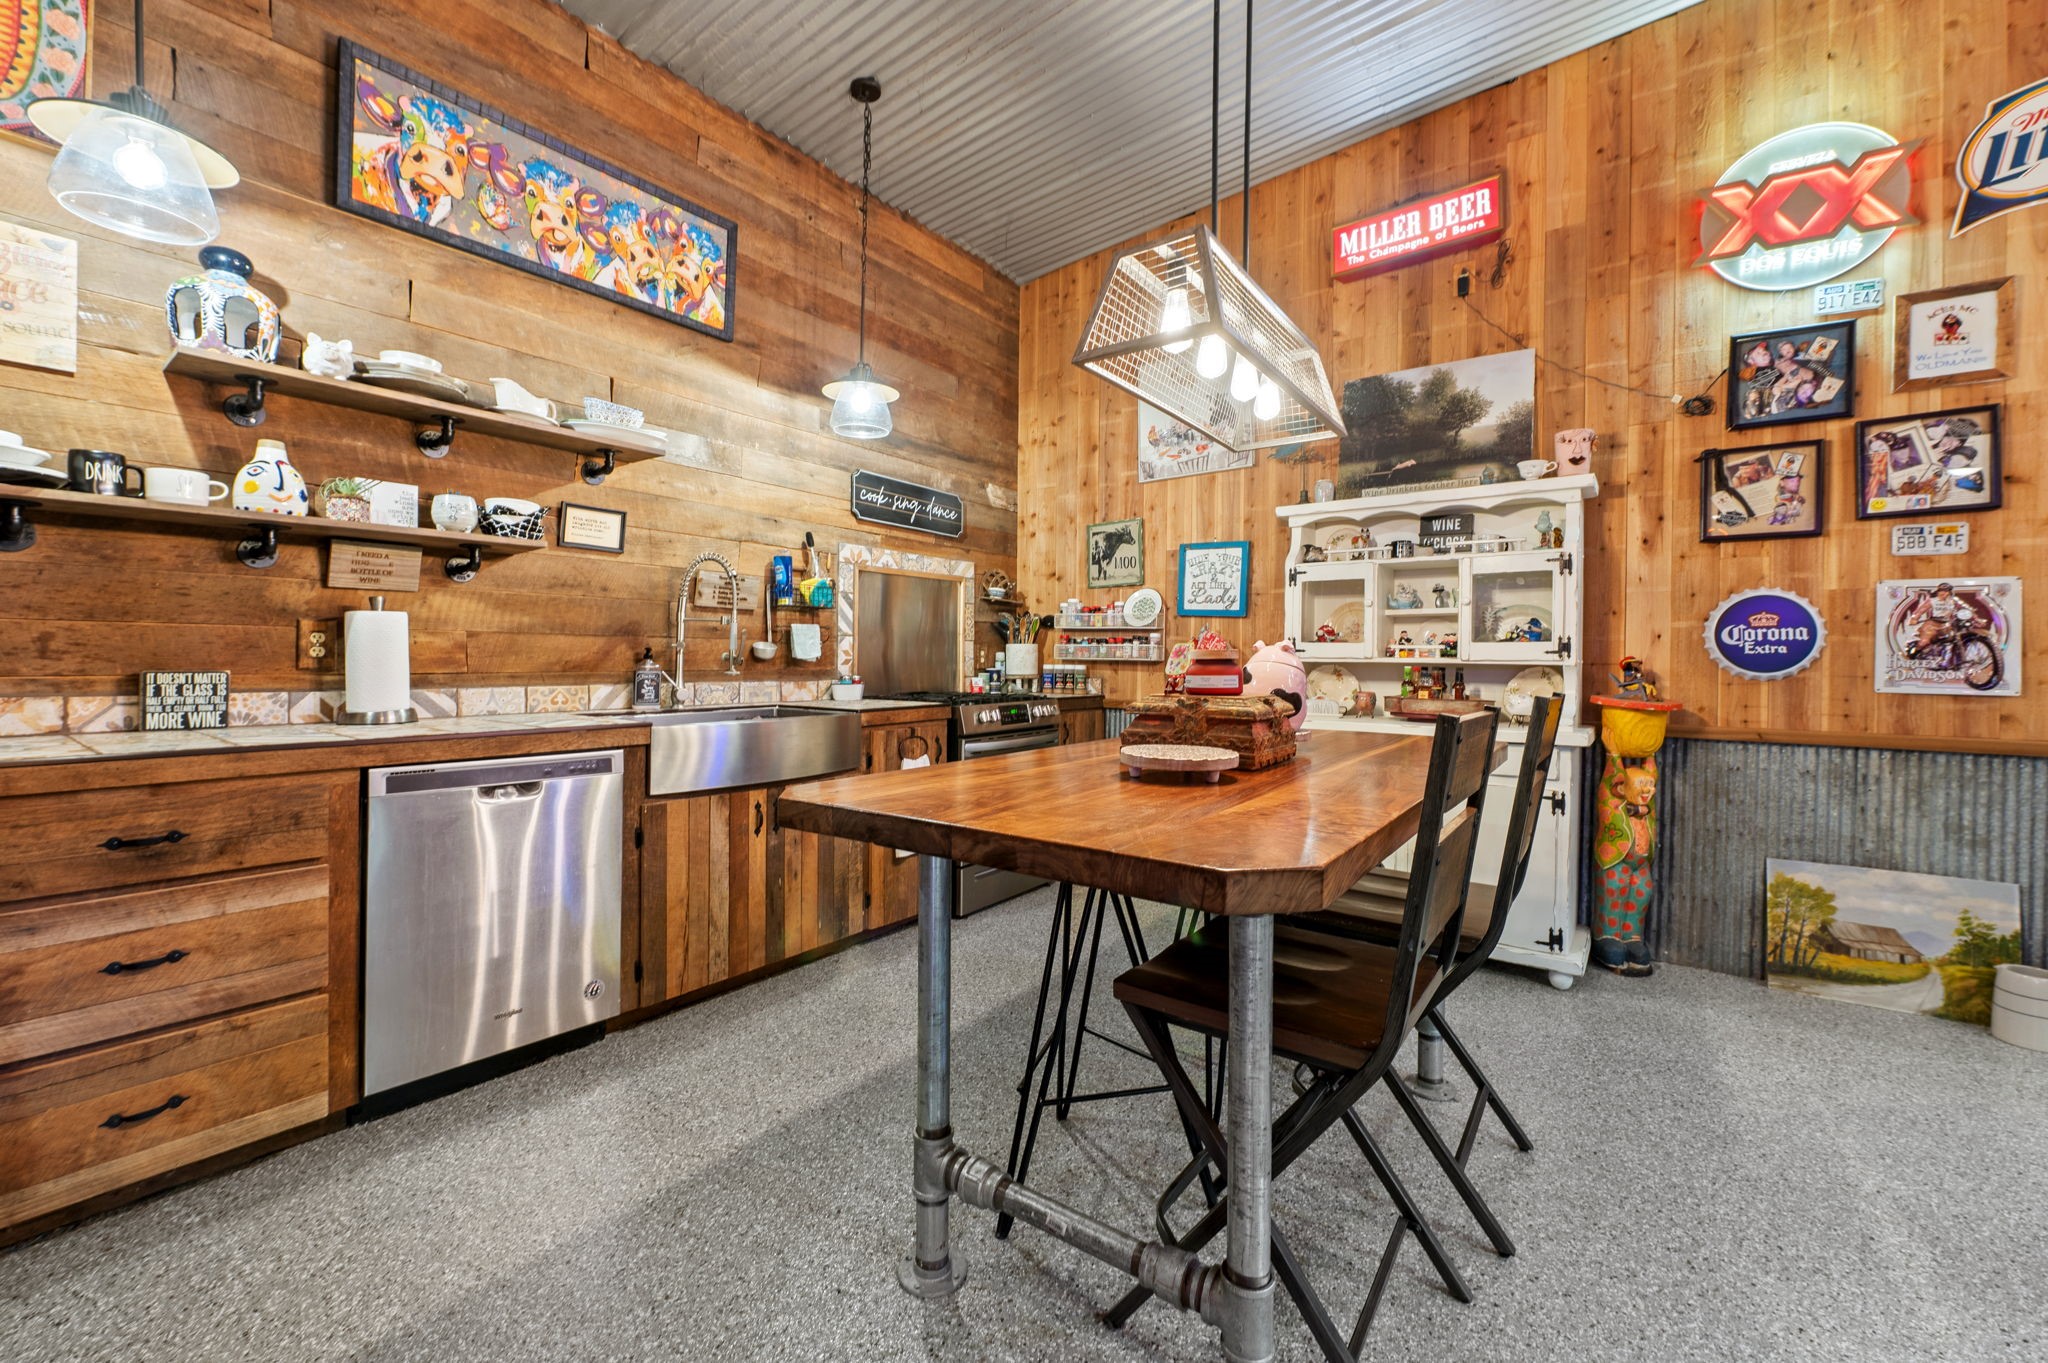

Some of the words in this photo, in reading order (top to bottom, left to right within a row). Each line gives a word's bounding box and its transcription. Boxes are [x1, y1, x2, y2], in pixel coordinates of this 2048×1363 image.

[1340, 210, 1421, 257] MILLER
[1429, 188, 1492, 231] BEER
[1347, 254, 1365, 265] The
[1369, 235, 1430, 259] Champagne
[1435, 229, 1447, 241] of
[1452, 218, 1486, 236] Beers
[1740, 251, 1787, 274] DOS
[1790, 237, 1864, 266] EQUIS
[1818, 294, 1846, 311] 917
[85, 461, 124, 484] DRINK
[1364, 489, 1383, 497] Wine
[860, 486, 888, 507] cook
[892, 495, 921, 524] sing
[926, 496, 958, 520] dance
[1432, 518, 1462, 532] WINE
[360, 551, 382, 559] NEED
[1114, 556, 1137, 569] MOO
[1187, 588, 1238, 610] Lady
[1721, 624, 1810, 647] Corona
[1744, 641, 1788, 654] Extra
[146, 673, 156, 684] IT
[157, 673, 193, 684] DOESN'T
[194, 672, 227, 684] MATTER
[146, 684, 157, 697] IF
[161, 684, 179, 696] THE
[217, 684, 227, 696] IS
[146, 712, 185, 730] MORE
[188, 711, 226, 728] WINE.
